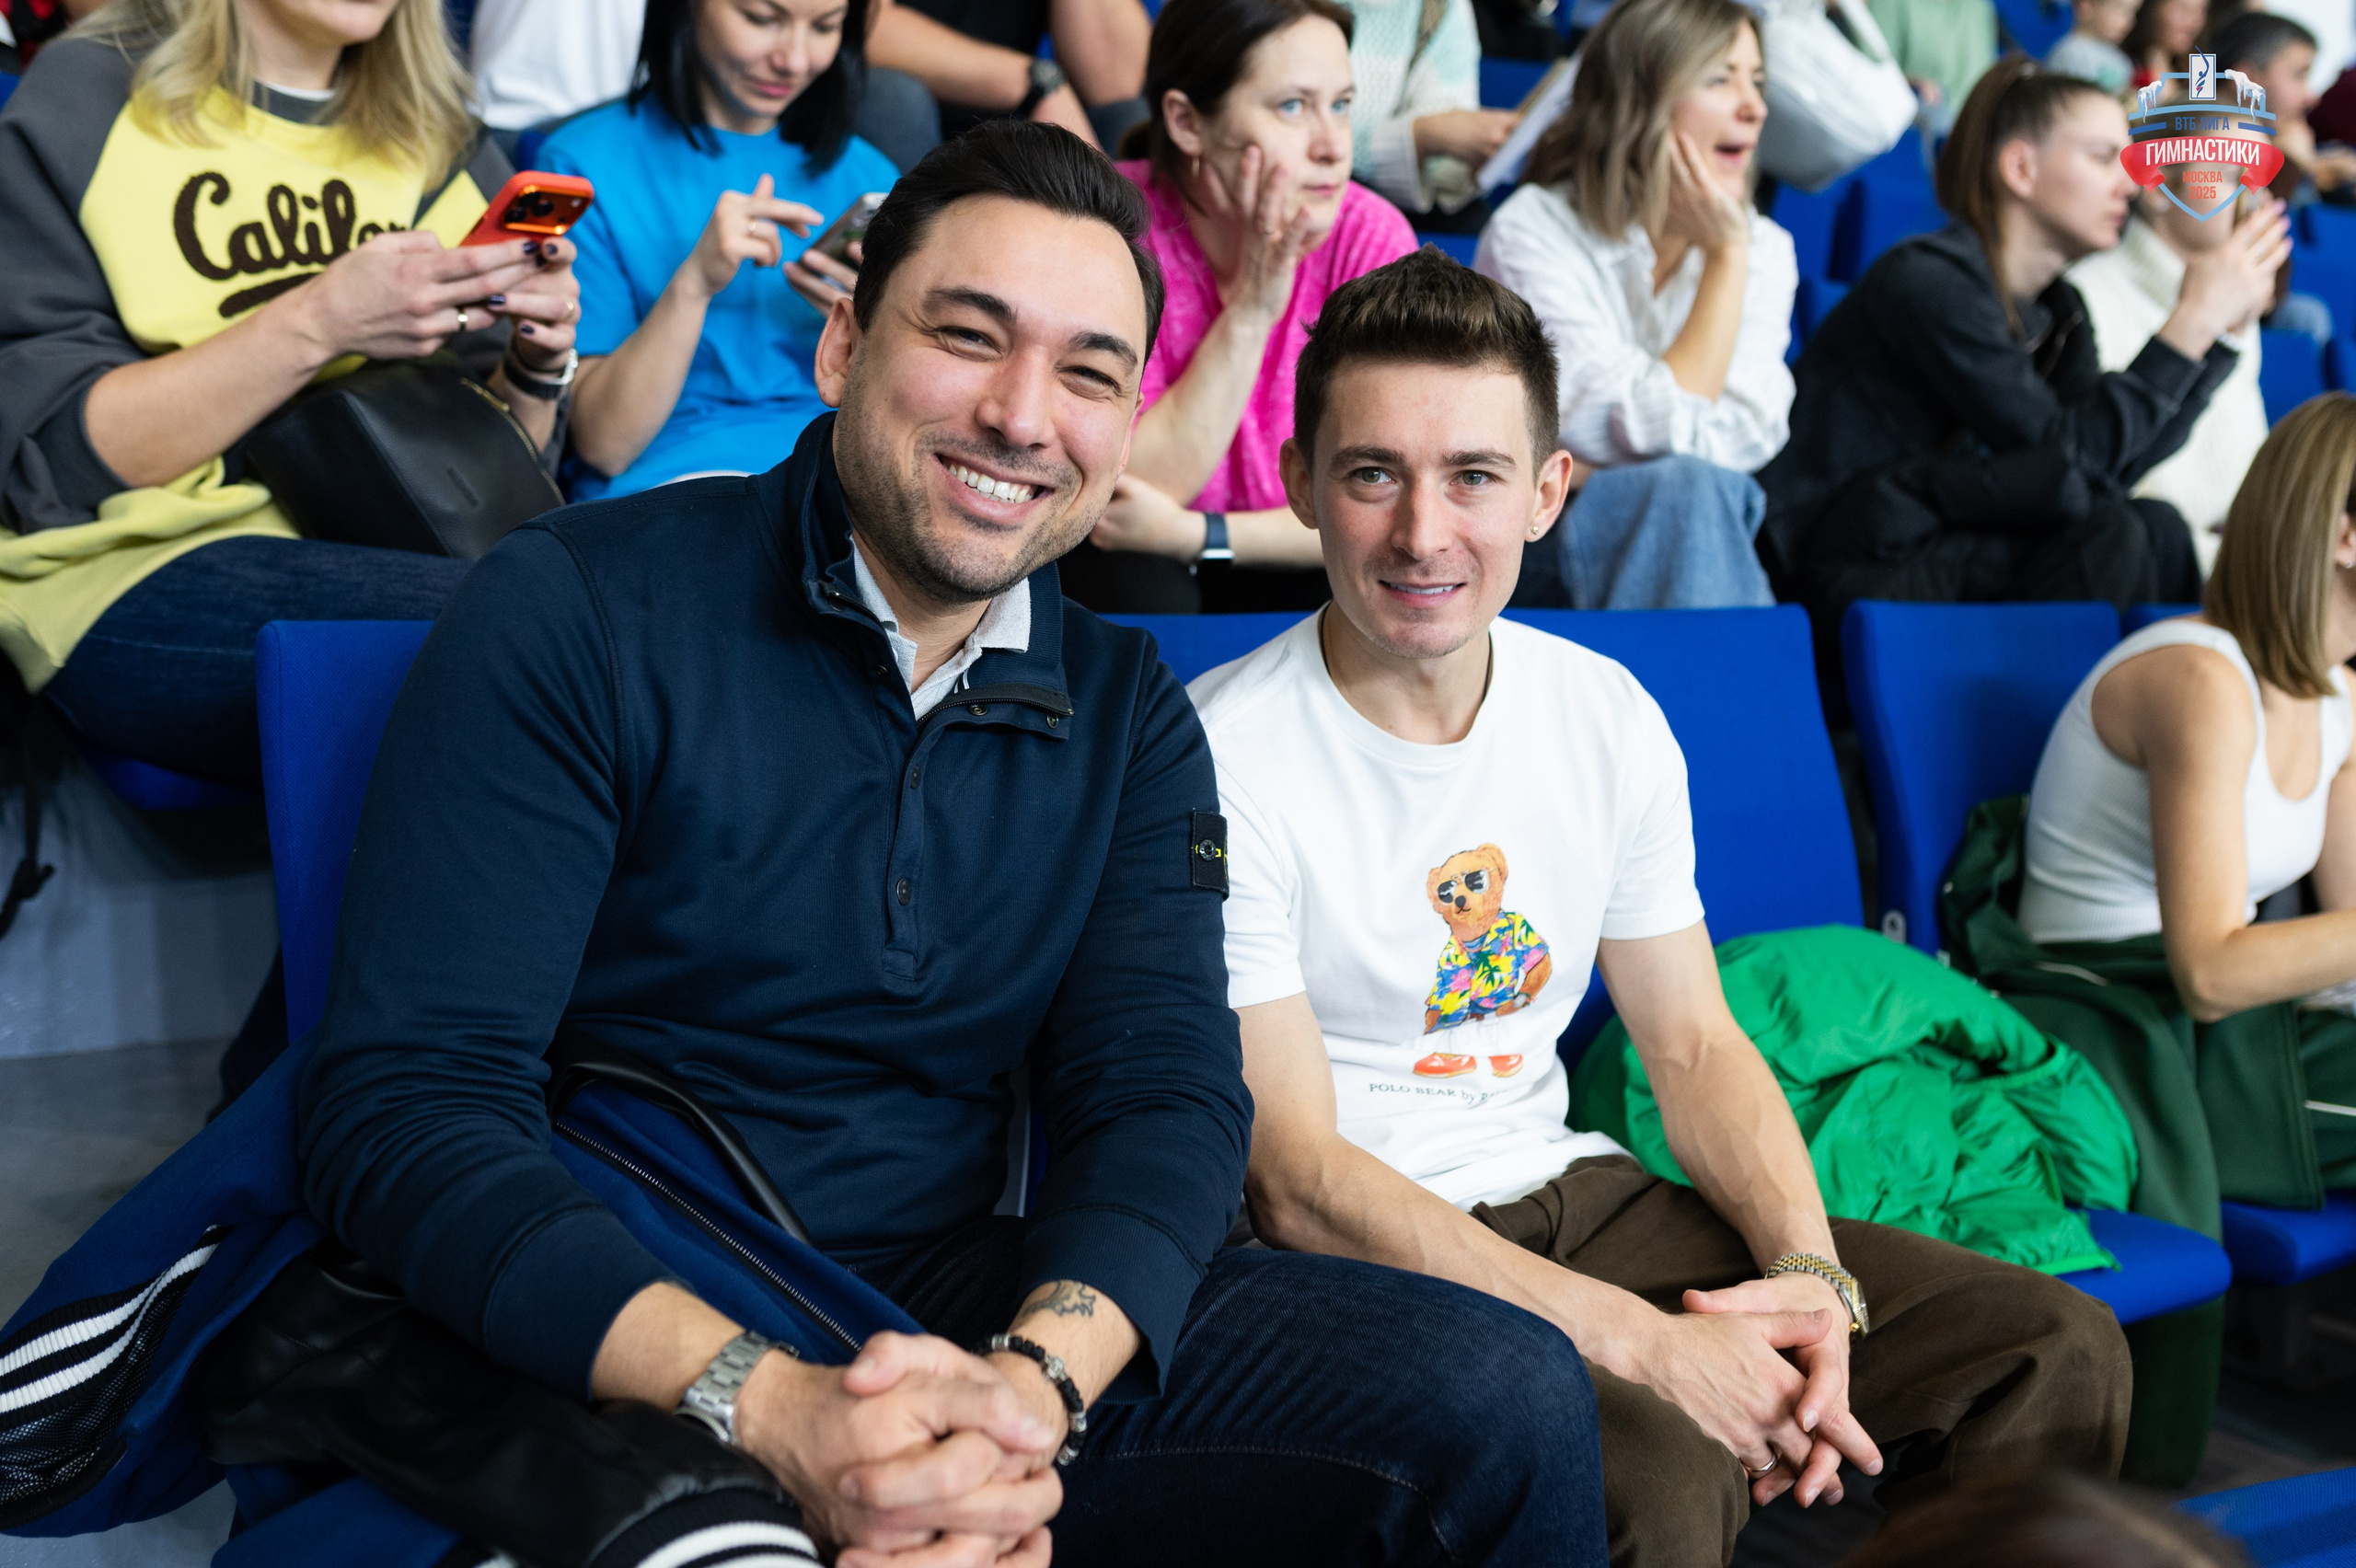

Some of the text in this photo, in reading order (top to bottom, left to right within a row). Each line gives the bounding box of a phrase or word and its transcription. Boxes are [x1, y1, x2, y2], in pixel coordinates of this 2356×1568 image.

[1369, 1083, 1411, 1093] POLO
[1415, 1087, 1457, 1097] BEAR
[1461, 1090, 1475, 1104] by
